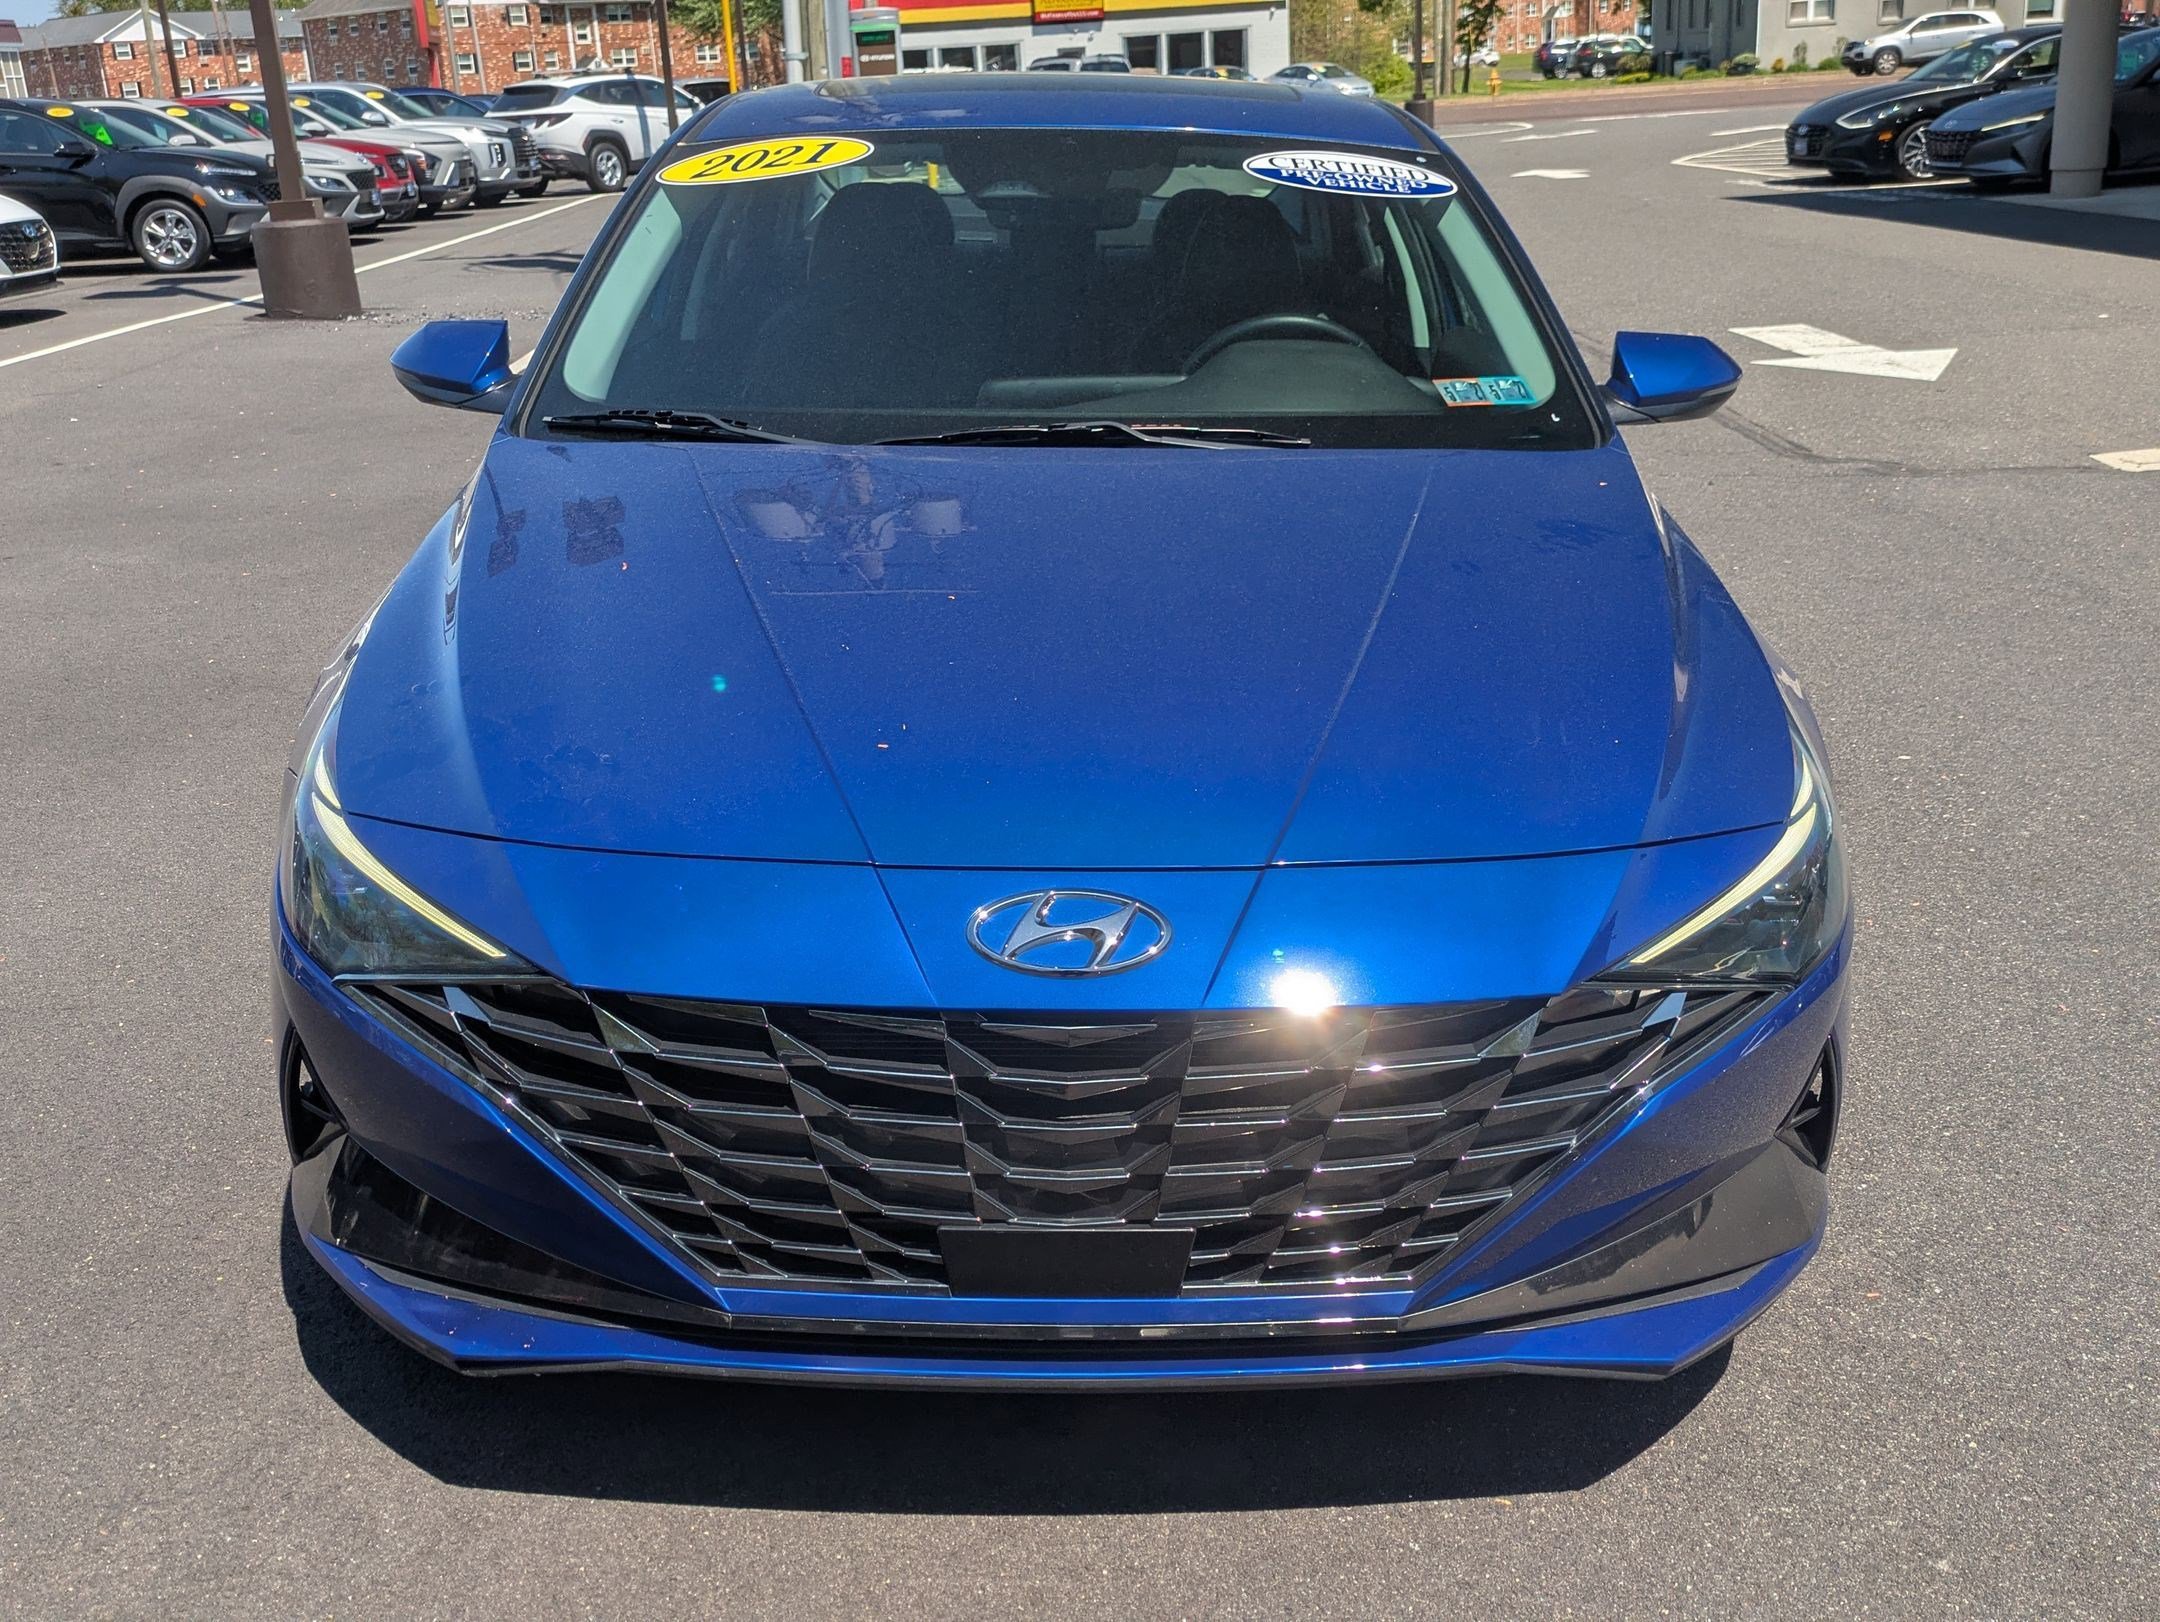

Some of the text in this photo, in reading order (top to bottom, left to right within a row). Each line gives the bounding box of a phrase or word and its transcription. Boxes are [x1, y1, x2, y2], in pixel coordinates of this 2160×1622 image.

[689, 142, 840, 179] 2021
[1268, 156, 1429, 182] CERTIFIED
[1280, 168, 1428, 189] PRE-OWNED
[1304, 178, 1412, 194] VEHICLE
